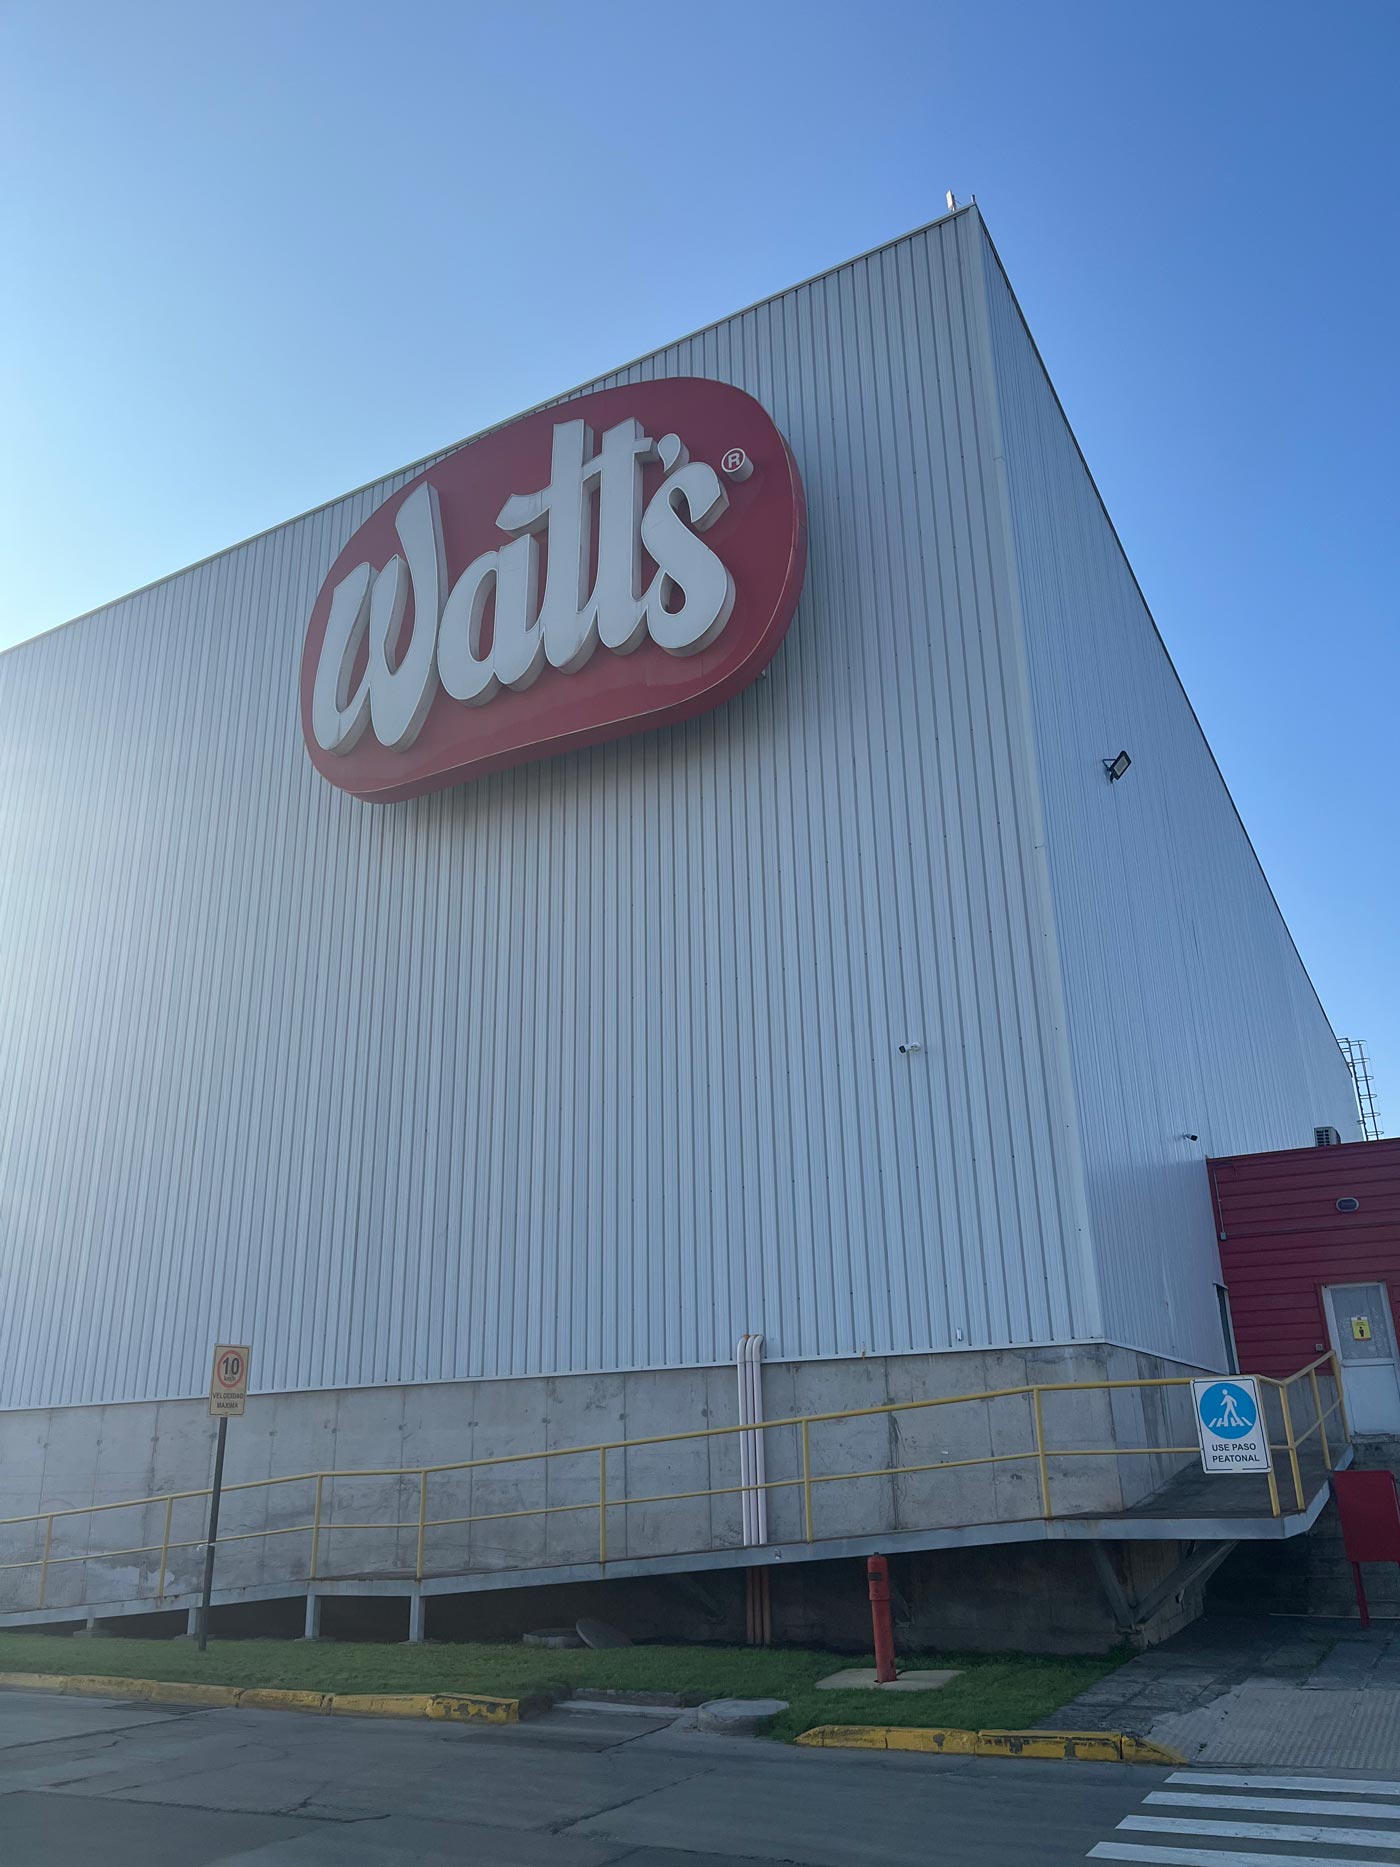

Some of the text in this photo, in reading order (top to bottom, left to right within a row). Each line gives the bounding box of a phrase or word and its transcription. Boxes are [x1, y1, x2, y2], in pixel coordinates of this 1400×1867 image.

[312, 416, 732, 754] Watt's
[222, 1357, 240, 1375] 10
[1212, 1442, 1257, 1451] USE PASO
[1212, 1454, 1260, 1462] PEATONAL
